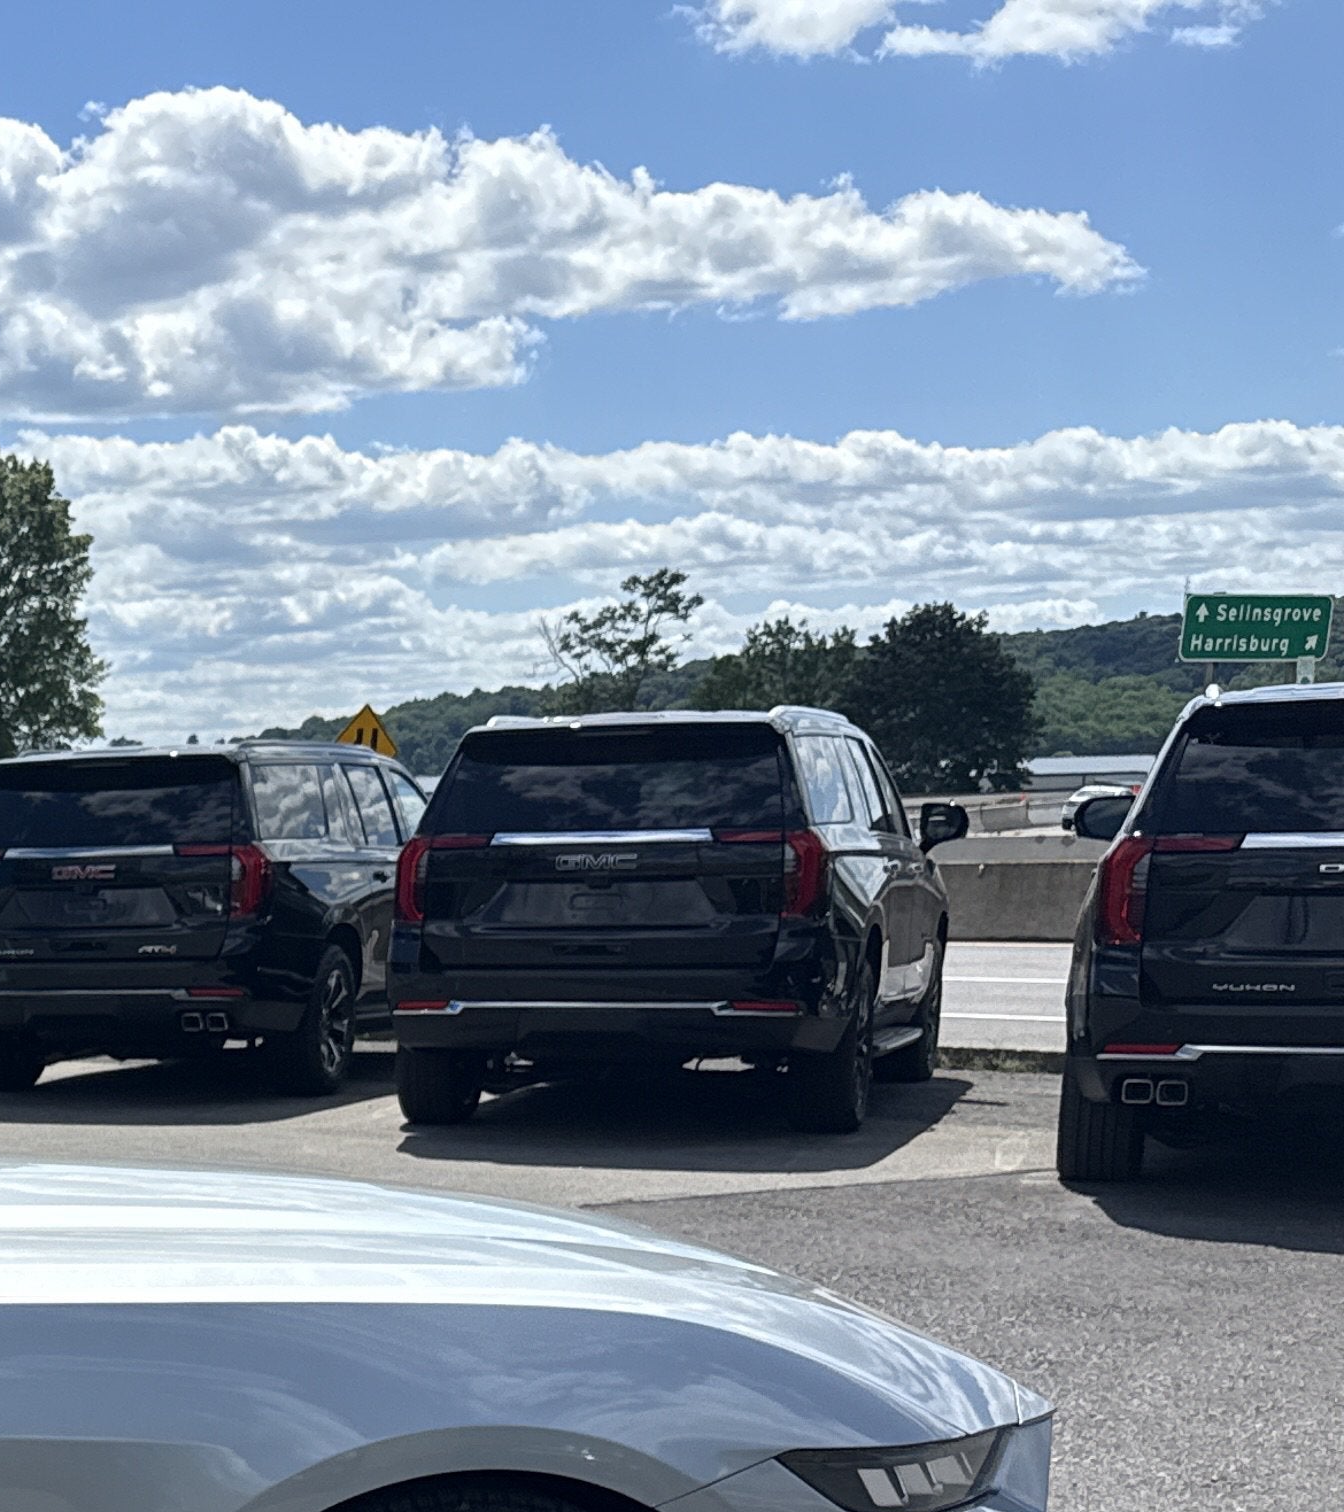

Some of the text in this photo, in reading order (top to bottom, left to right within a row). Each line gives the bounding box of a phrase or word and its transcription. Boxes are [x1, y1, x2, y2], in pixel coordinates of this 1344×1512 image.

[1216, 603, 1322, 627] Selinsgrove
[1189, 633, 1290, 656] Harrisburg
[555, 853, 639, 871] GMC
[51, 864, 116, 881] GMC
[1212, 983, 1296, 992] YUKON
